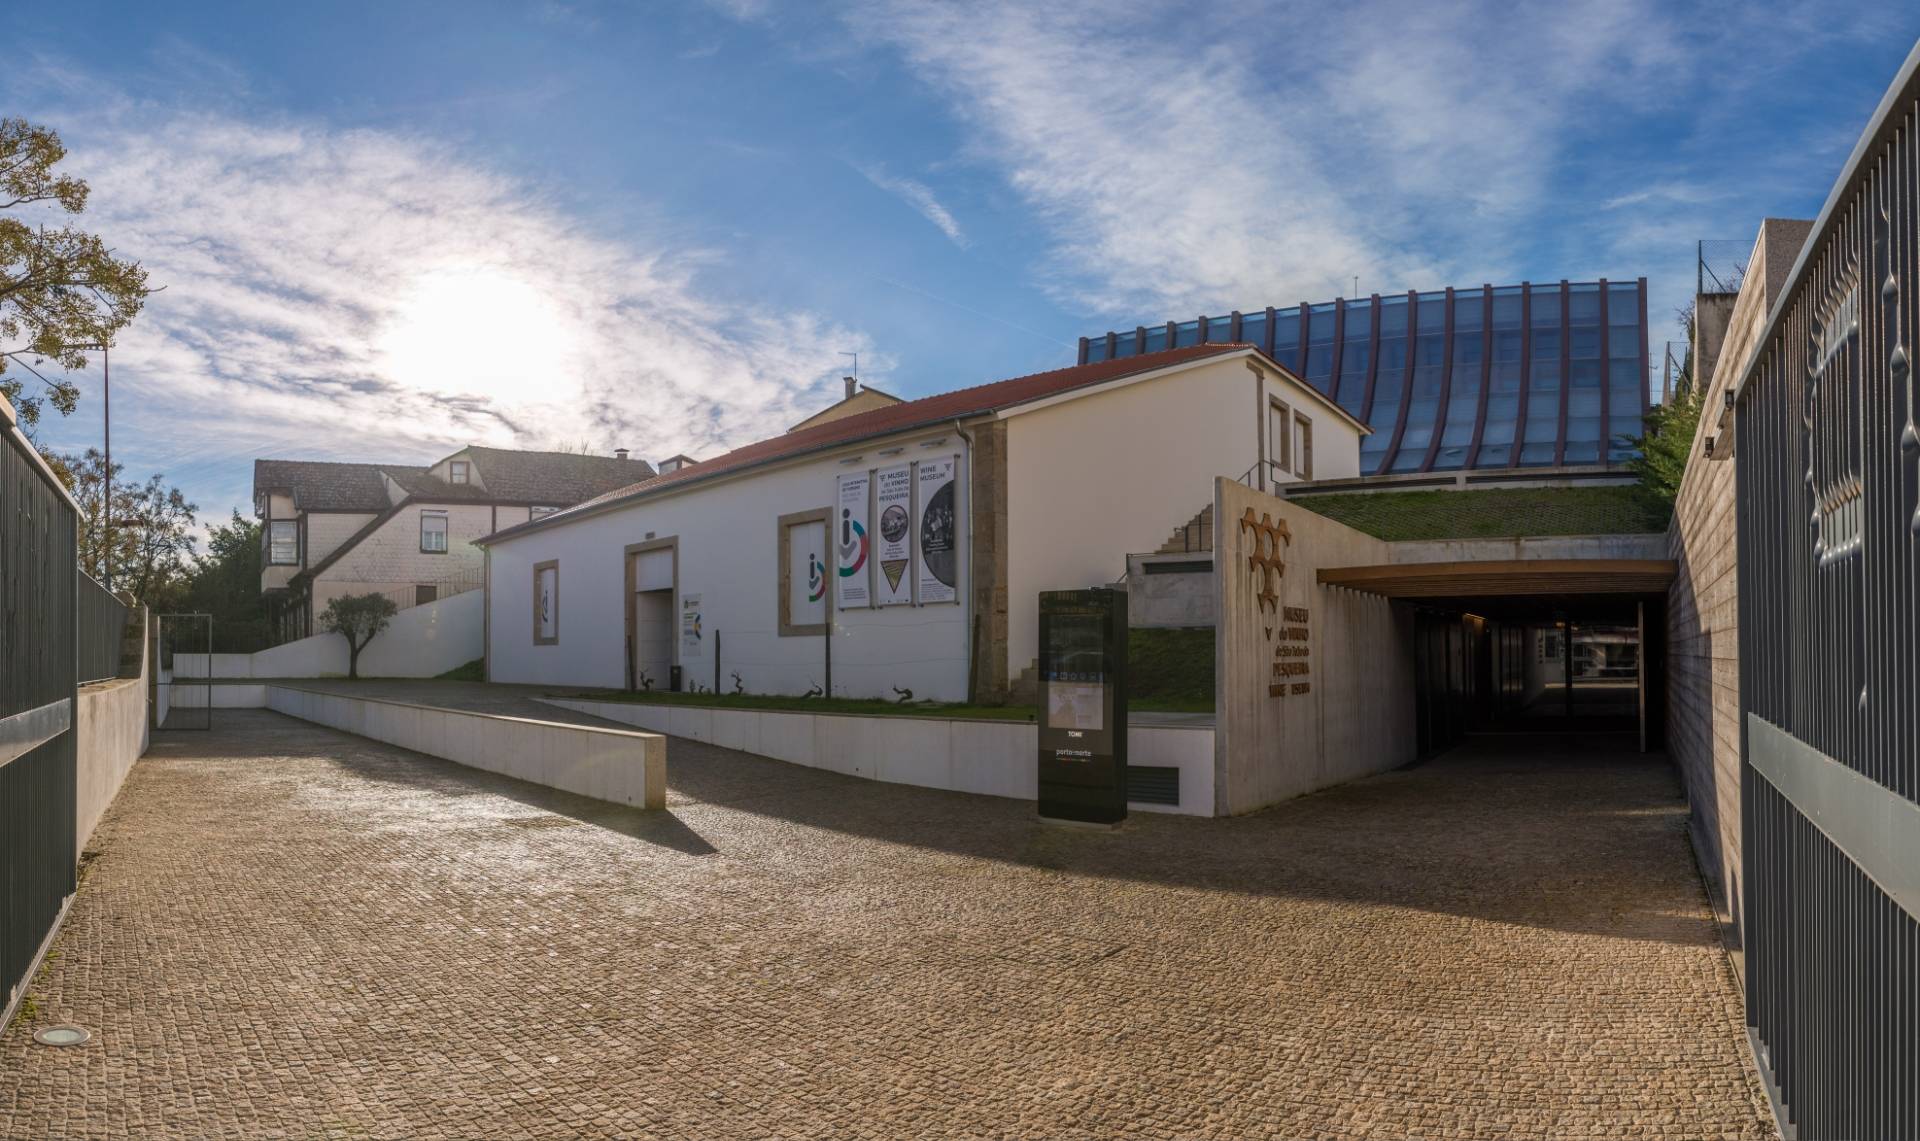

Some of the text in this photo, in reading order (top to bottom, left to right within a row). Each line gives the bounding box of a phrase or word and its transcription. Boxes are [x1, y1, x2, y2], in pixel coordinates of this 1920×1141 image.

[888, 470, 909, 480] MUSEU
[920, 472, 945, 481] MUSEUM
[1283, 606, 1309, 624] MUSEU
